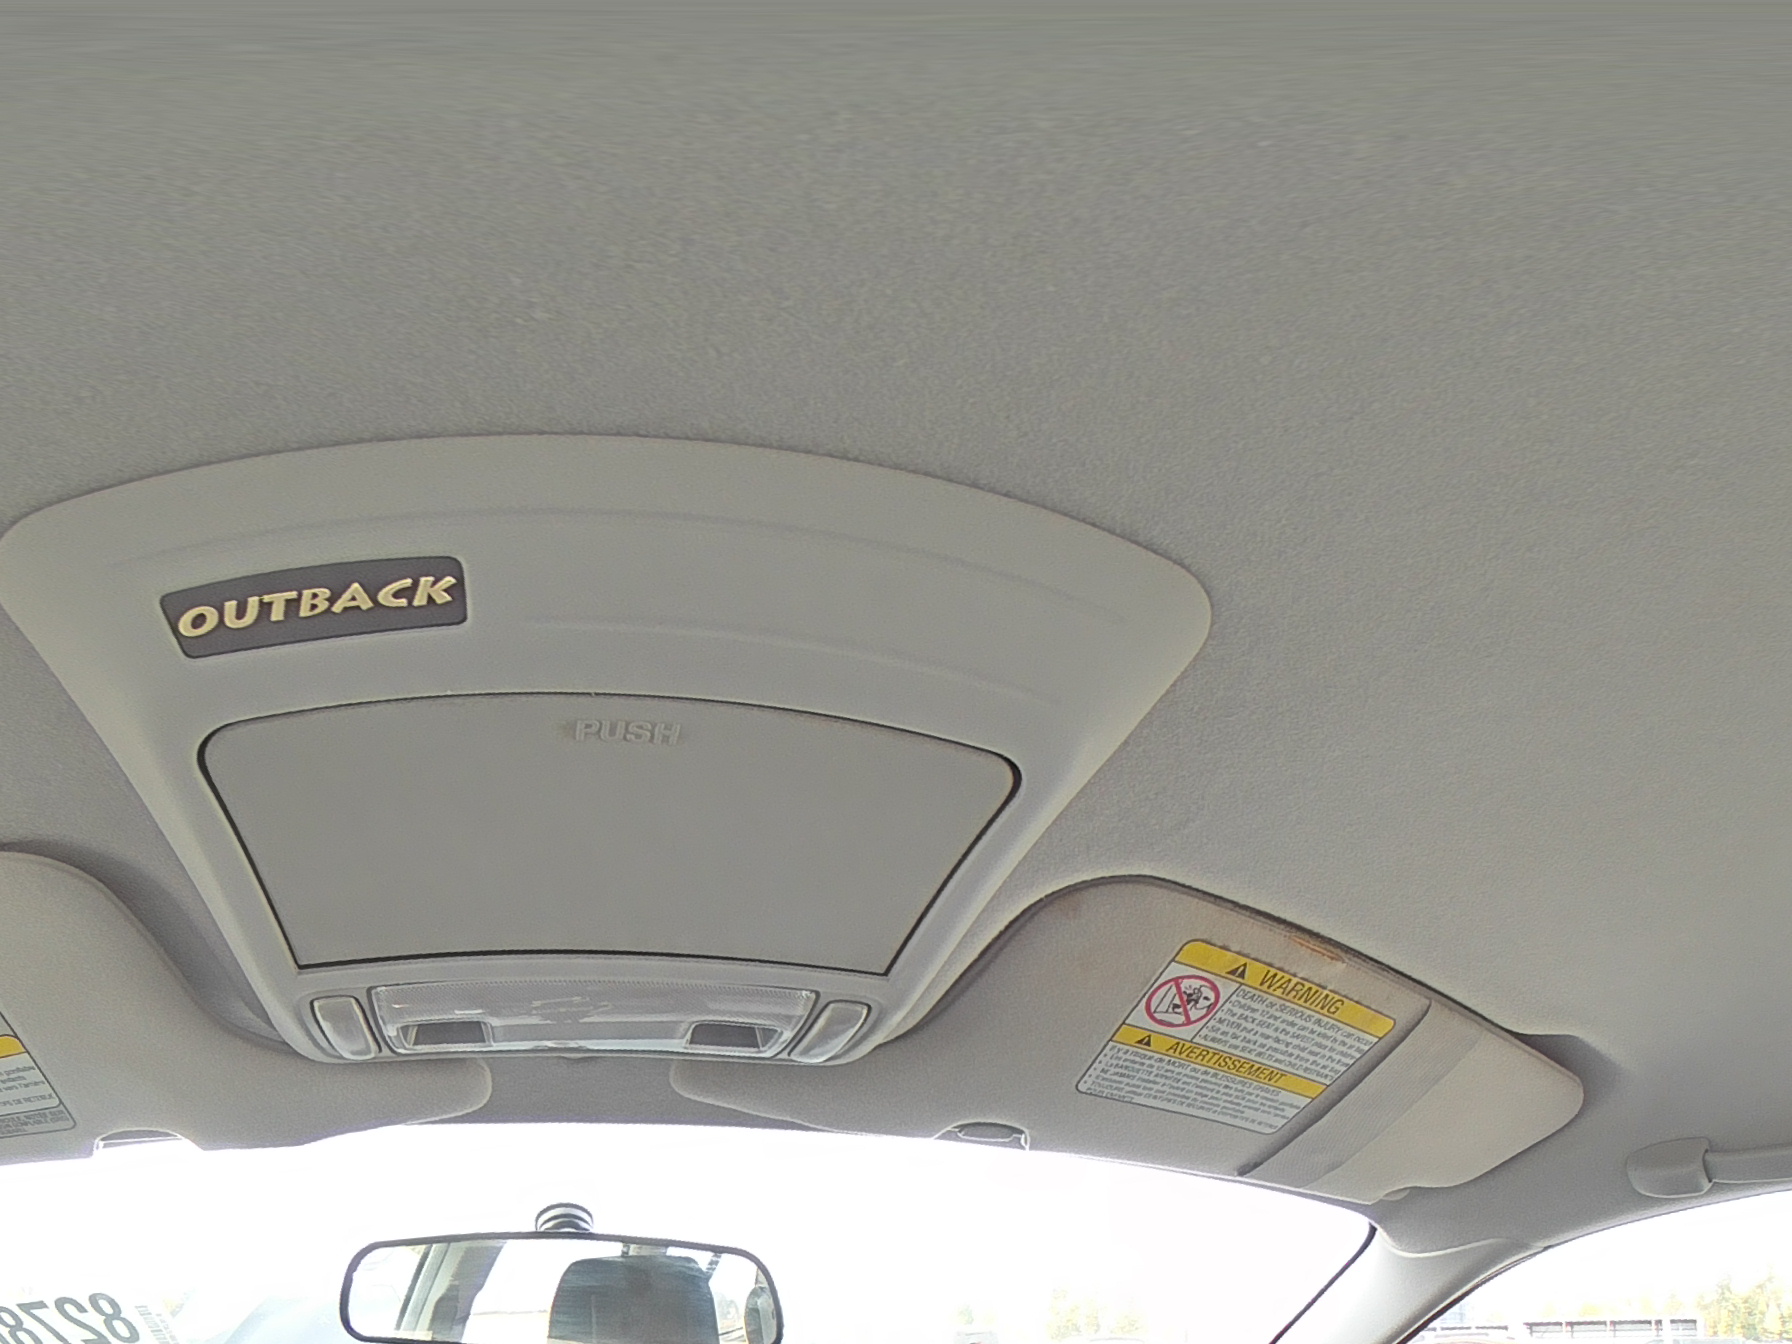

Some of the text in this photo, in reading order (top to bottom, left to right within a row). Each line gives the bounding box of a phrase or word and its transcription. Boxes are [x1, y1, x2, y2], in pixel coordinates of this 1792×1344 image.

[176, 575, 457, 639] OUTBACK
[572, 718, 683, 746] PUSH
[1236, 988, 1268, 1004] DEATH
[1275, 1003, 1314, 1022] SERIOUS
[1259, 970, 1343, 1014] WARNING
[1166, 1041, 1286, 1082] AVERTISSEMENT
